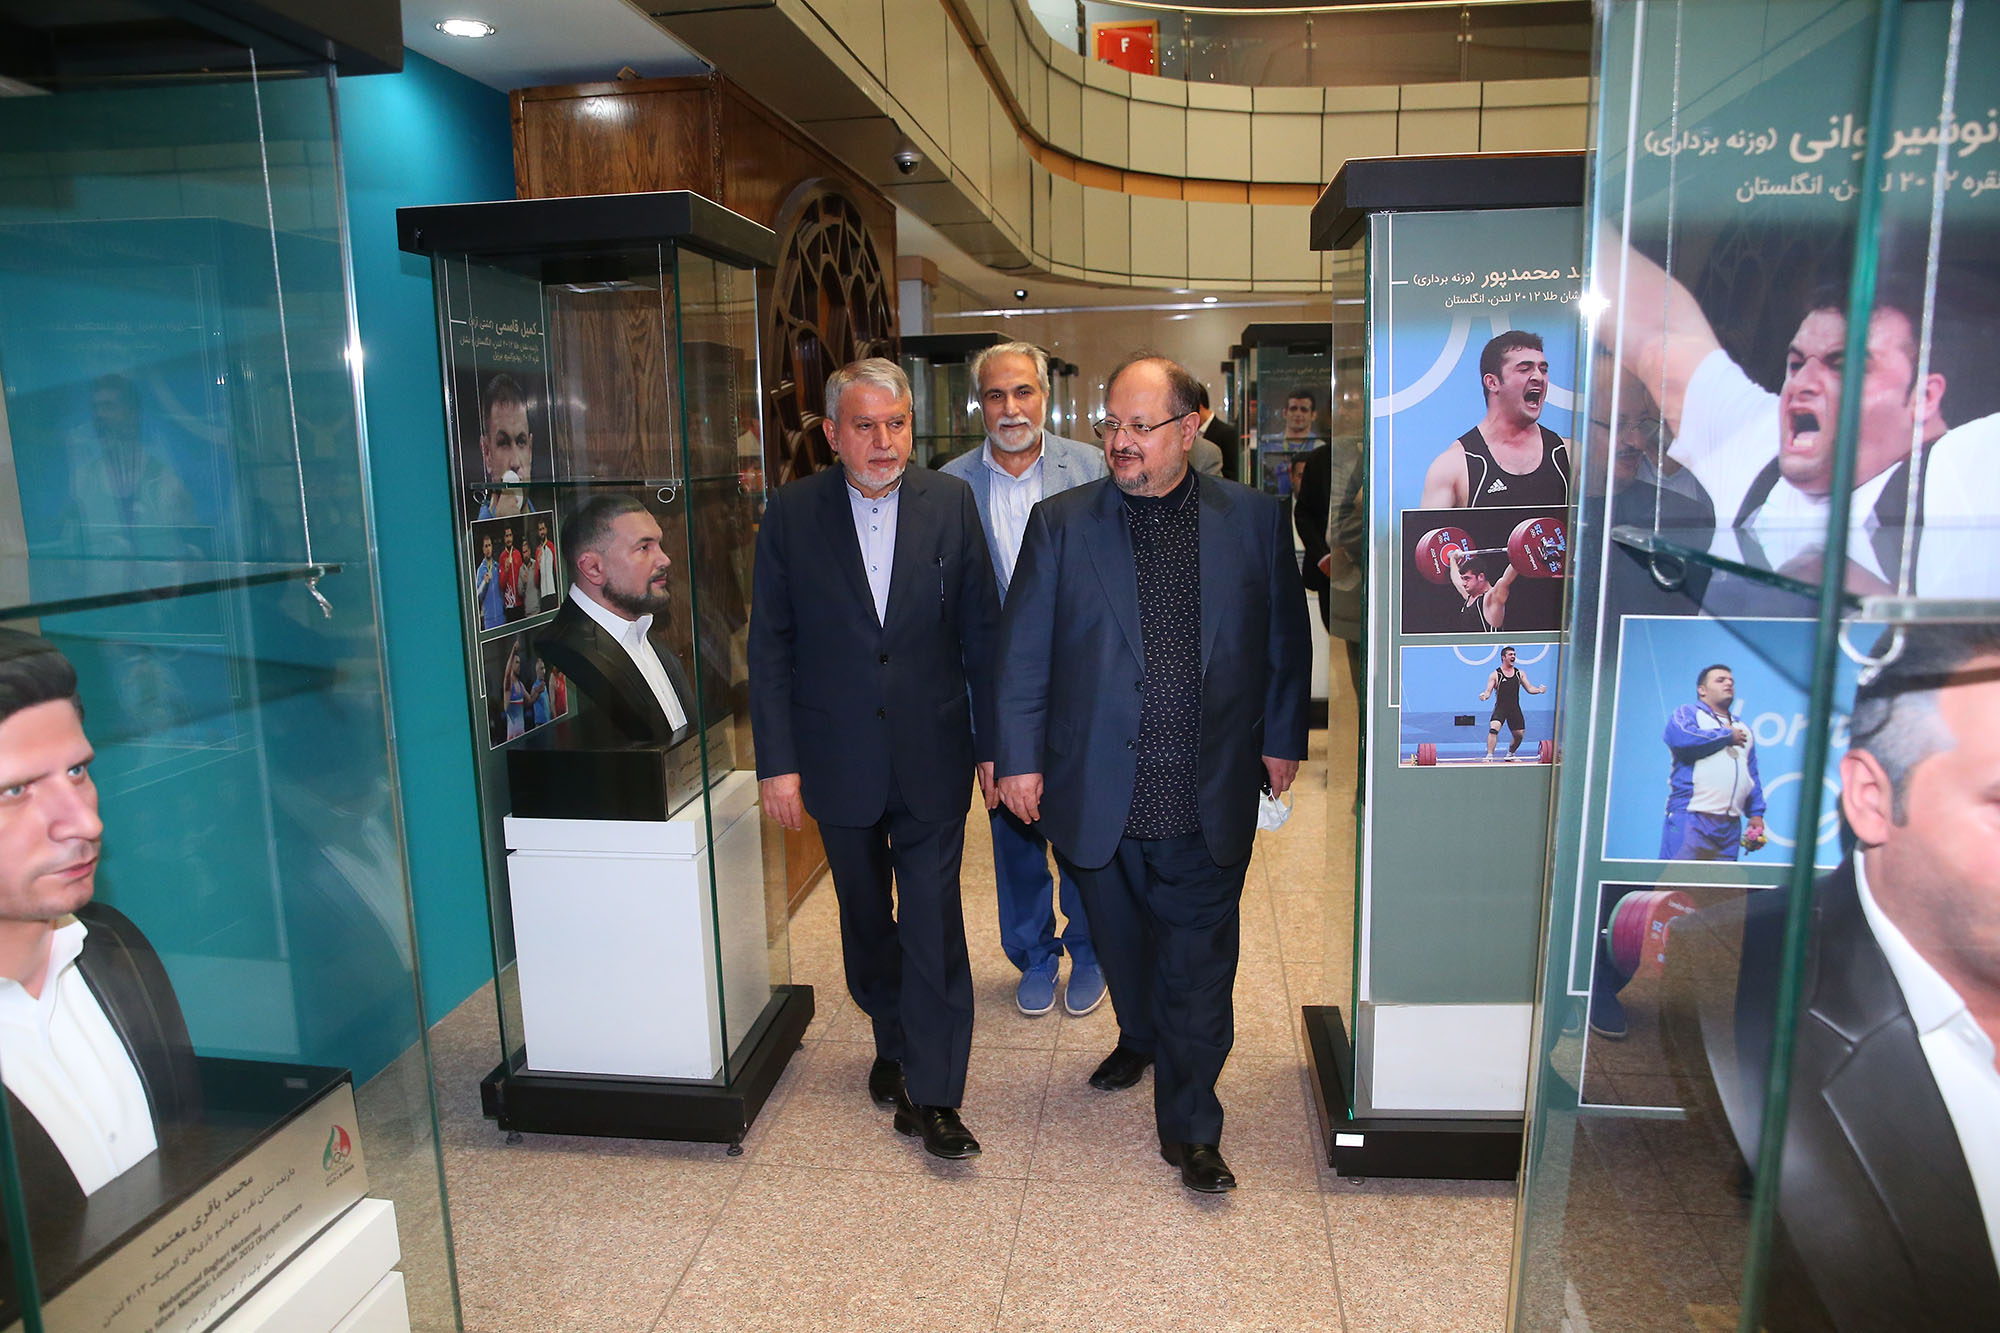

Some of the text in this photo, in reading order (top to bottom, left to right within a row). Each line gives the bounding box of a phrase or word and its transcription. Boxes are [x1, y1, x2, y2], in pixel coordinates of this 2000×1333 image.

[1121, 38, 1131, 53] F
[1644, 130, 1720, 157] برداری)
[1727, 127, 1778, 156] (وزنه
[1736, 171, 1824, 203] انگلستان
[1413, 273, 1449, 287] برداری)
[1451, 271, 1475, 286] (وزنه
[1480, 267, 1561, 289] محمدپور
[1445, 292, 1485, 308] انگلستان
[1514, 291, 1541, 302] ۲۰۱۲
[1542, 291, 1558, 302] طلا
[1560, 290, 1581, 304] شان
[495, 319, 519, 336] قاسمی
[152, 1175, 254, 1258] محمد باقری معتمد
[212, 1256, 239, 1281] London
[239, 1240, 256, 1260] 2012
[255, 1221, 281, 1246] Olympic
[282, 1203, 303, 1223] Games
